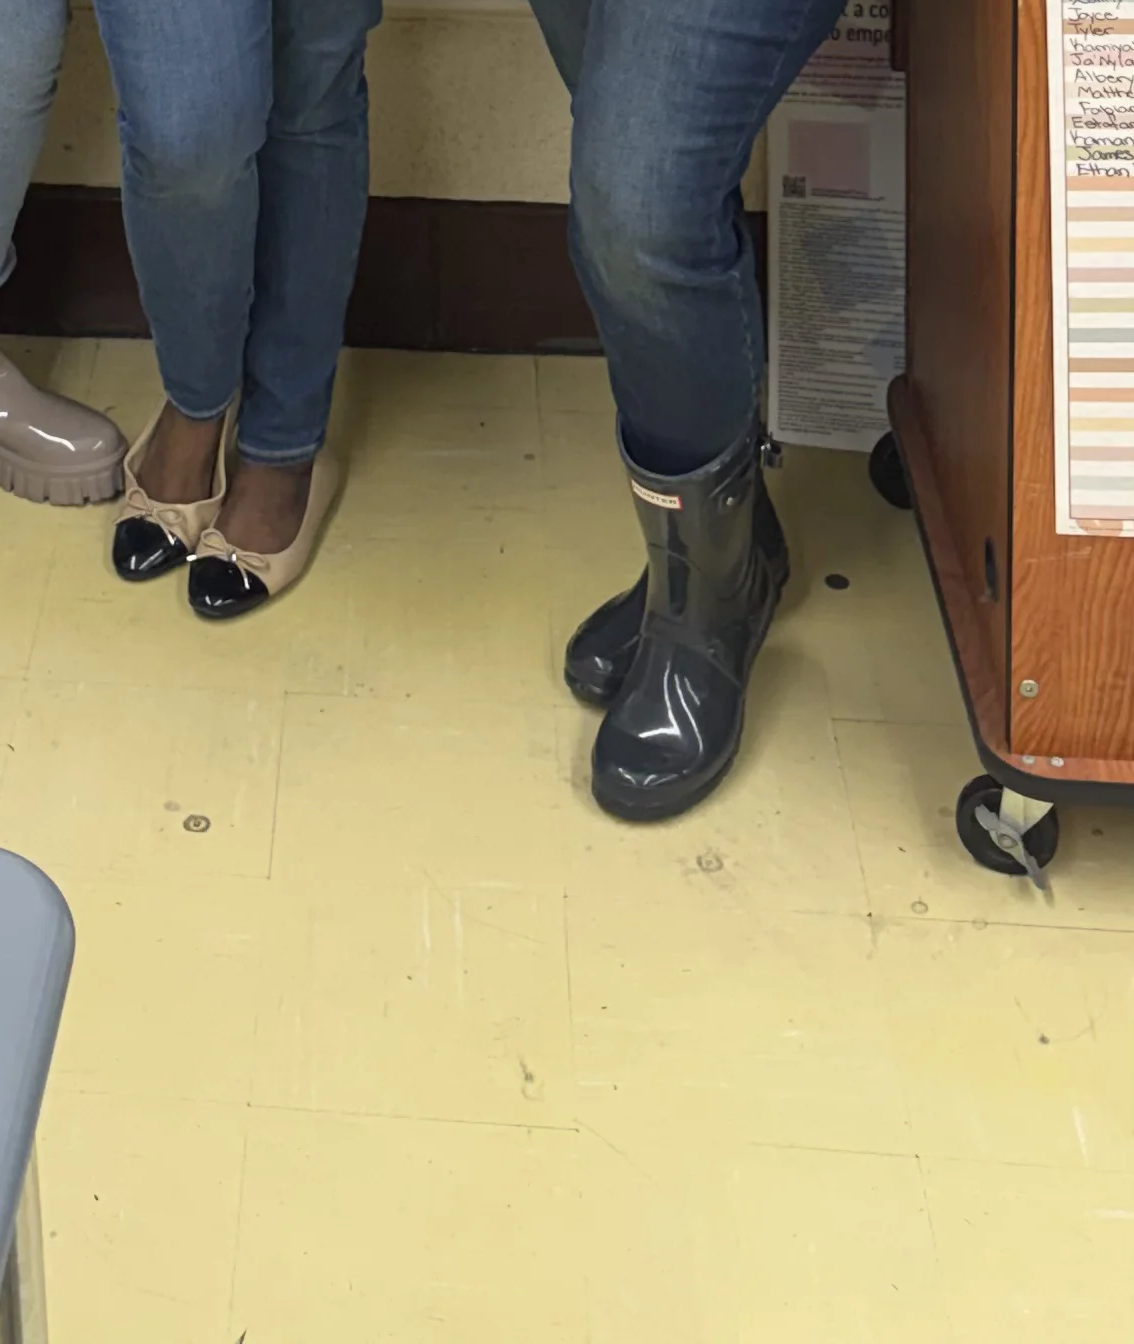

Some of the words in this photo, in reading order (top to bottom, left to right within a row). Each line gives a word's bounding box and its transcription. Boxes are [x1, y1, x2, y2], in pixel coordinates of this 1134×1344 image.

[1068, 7, 1119, 24] Joyce
[1068, 22, 1115, 41] Tyler
[1076, 163, 1131, 178] Ethan
